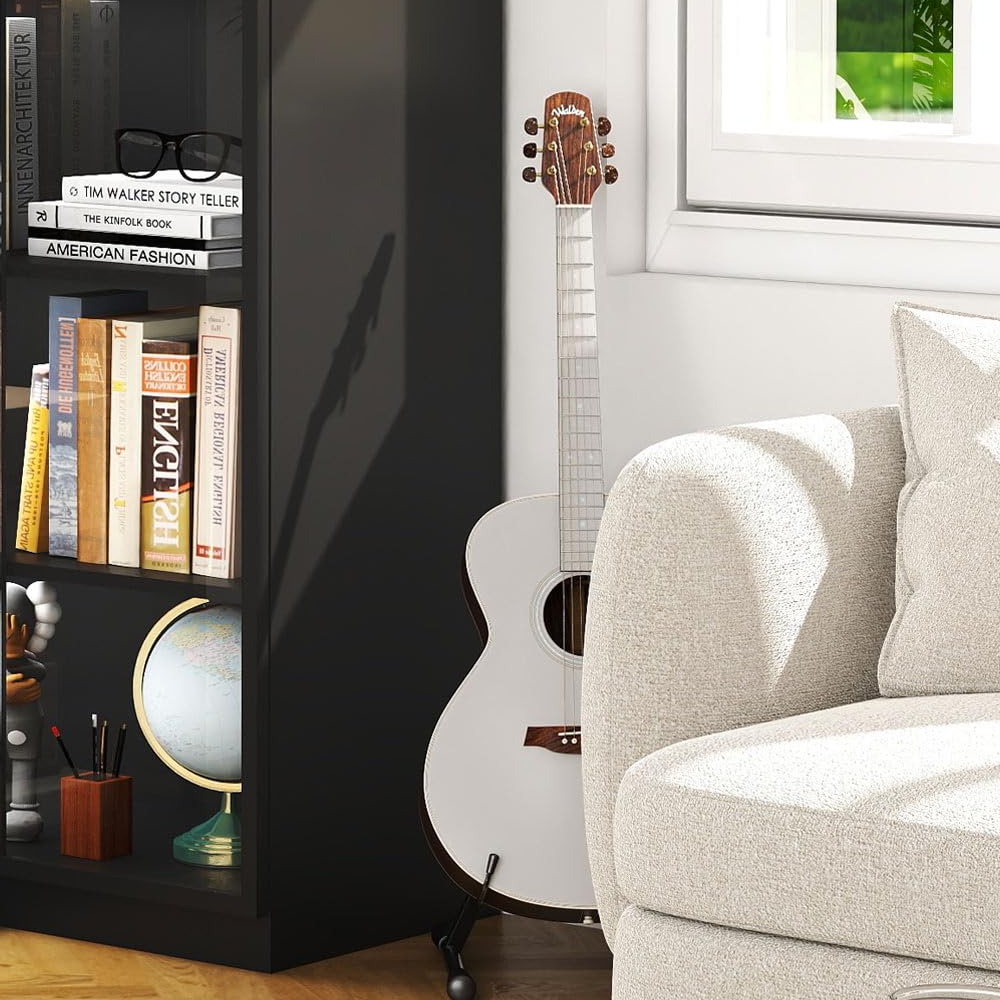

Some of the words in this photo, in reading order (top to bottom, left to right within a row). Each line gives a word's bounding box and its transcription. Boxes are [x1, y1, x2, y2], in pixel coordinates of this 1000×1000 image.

[14, 33, 33, 214] INNENARCHITEKTUR
[83, 186, 103, 198] TIM
[107, 187, 154, 202] WALKER
[158, 191, 197, 205] STORY
[200, 193, 240, 208] TELLER
[83, 215, 100, 224] THE
[104, 216, 143, 227] KINFOLK
[146, 218, 172, 229] BOOK
[46, 243, 125, 260] AMERICAN
[130, 250, 196, 266] FASHION
